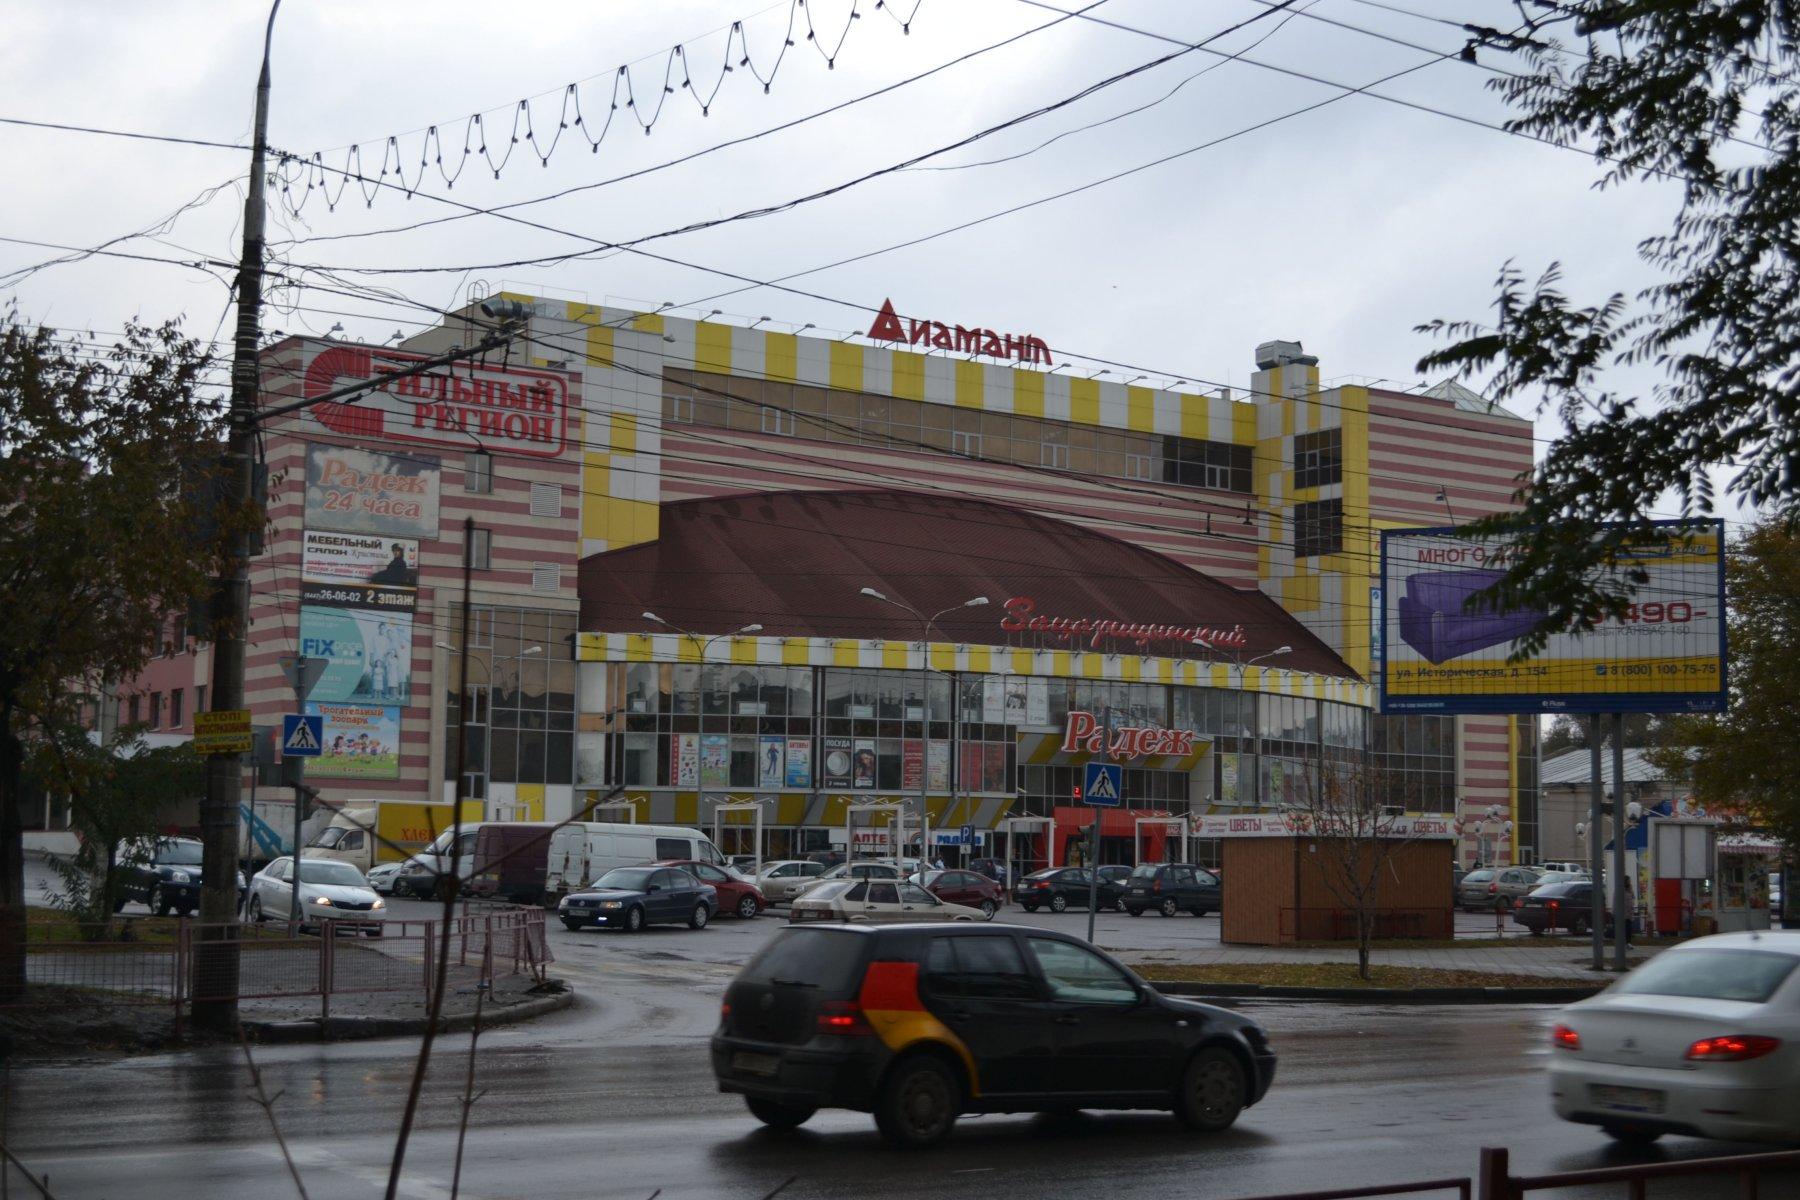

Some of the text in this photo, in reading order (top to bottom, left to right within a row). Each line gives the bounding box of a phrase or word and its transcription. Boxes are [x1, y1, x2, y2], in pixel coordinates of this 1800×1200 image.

[411, 403, 556, 443] РЕГИОН
[318, 457, 428, 495] Радеж
[323, 489, 421, 518] 24 часа
[307, 535, 383, 549] МЕБЕЛЬНЫЙ
[1418, 547, 1486, 563] МНОГО
[367, 590, 376, 603] 2
[378, 593, 415, 606] этаж
[1527, 666, 1547, 676] 154
[1610, 664, 1716, 676] 8 (800) 100-75-75
[319, 704, 385, 717] Трогательный
[331, 715, 369, 725] зоопарк
[1061, 711, 1194, 760] Радеж
[1229, 818, 1262, 832] ЦВЕТЫ
[1413, 821, 1448, 833] ЦВЕТЫ
[962, 826, 970, 839] P
